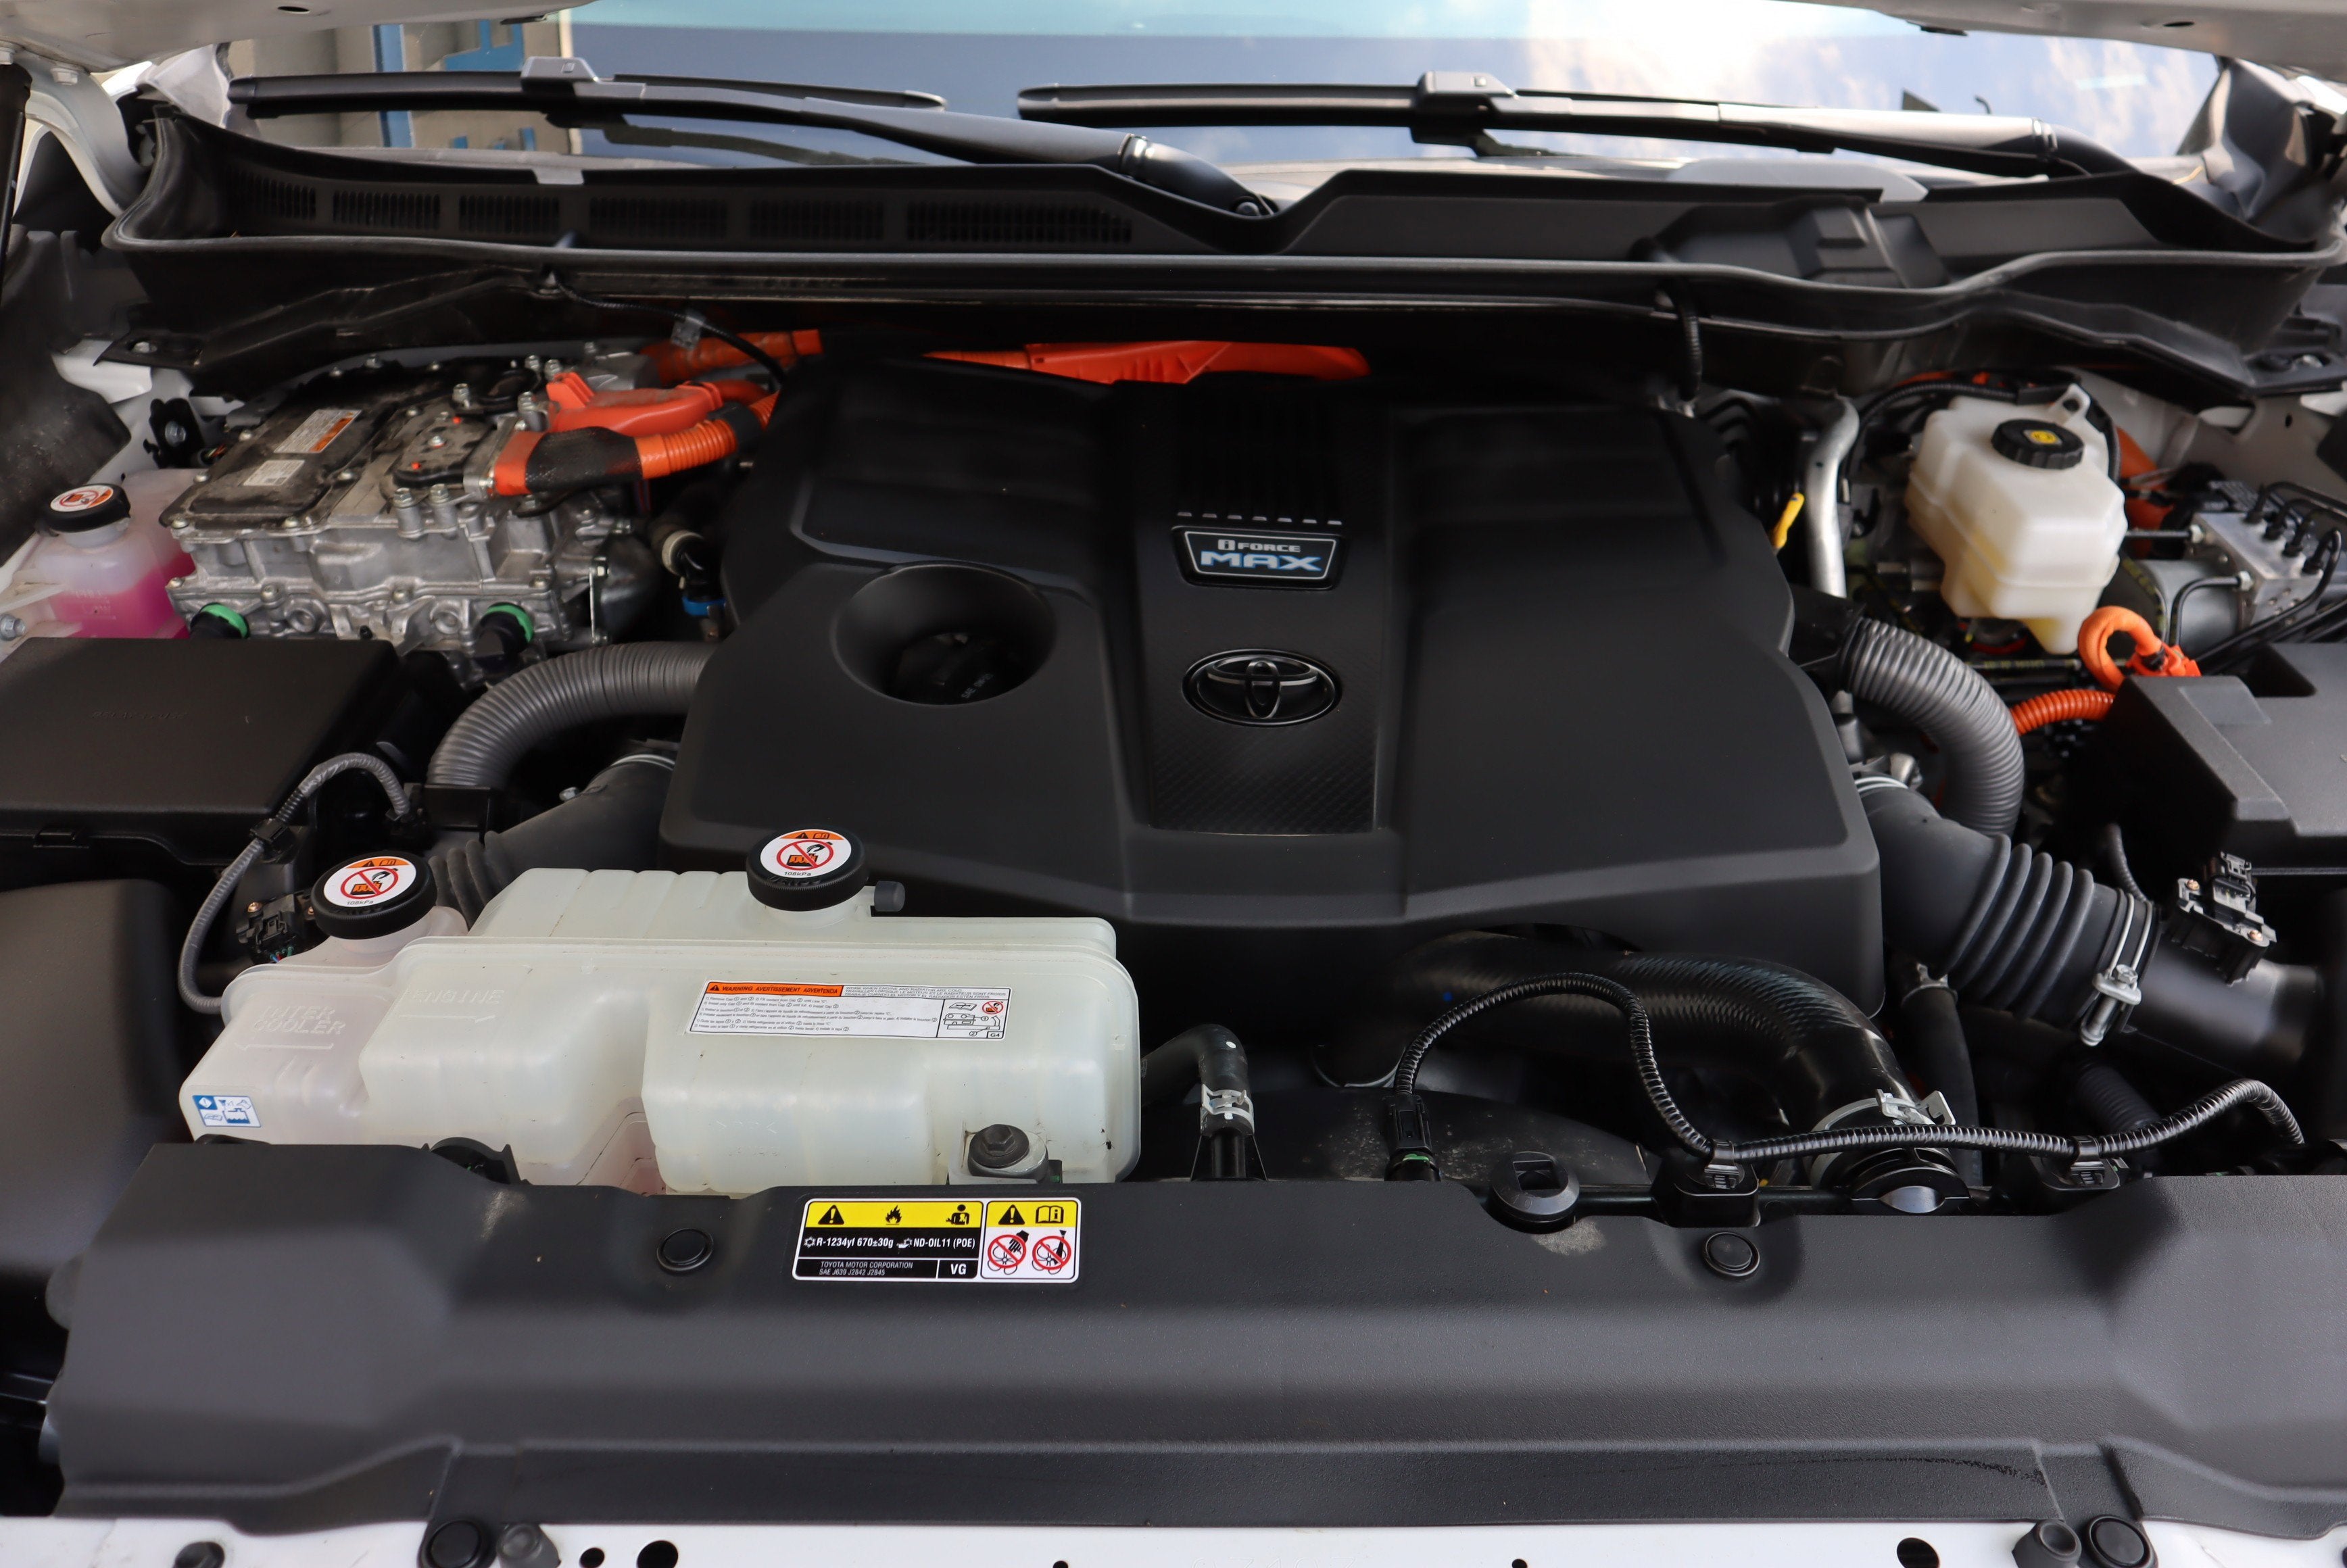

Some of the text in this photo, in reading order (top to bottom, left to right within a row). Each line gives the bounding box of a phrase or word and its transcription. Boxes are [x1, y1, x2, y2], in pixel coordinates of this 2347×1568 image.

[1201, 551, 1322, 571] MAX
[412, 989, 505, 1005] ENGINE
[259, 1006, 335, 1020] INTER
[253, 1018, 347, 1035] COOLER
[816, 1237, 975, 1249] R-1234yf 670±30g ND-OIL11 (POE)
[950, 1263, 967, 1275] VG
